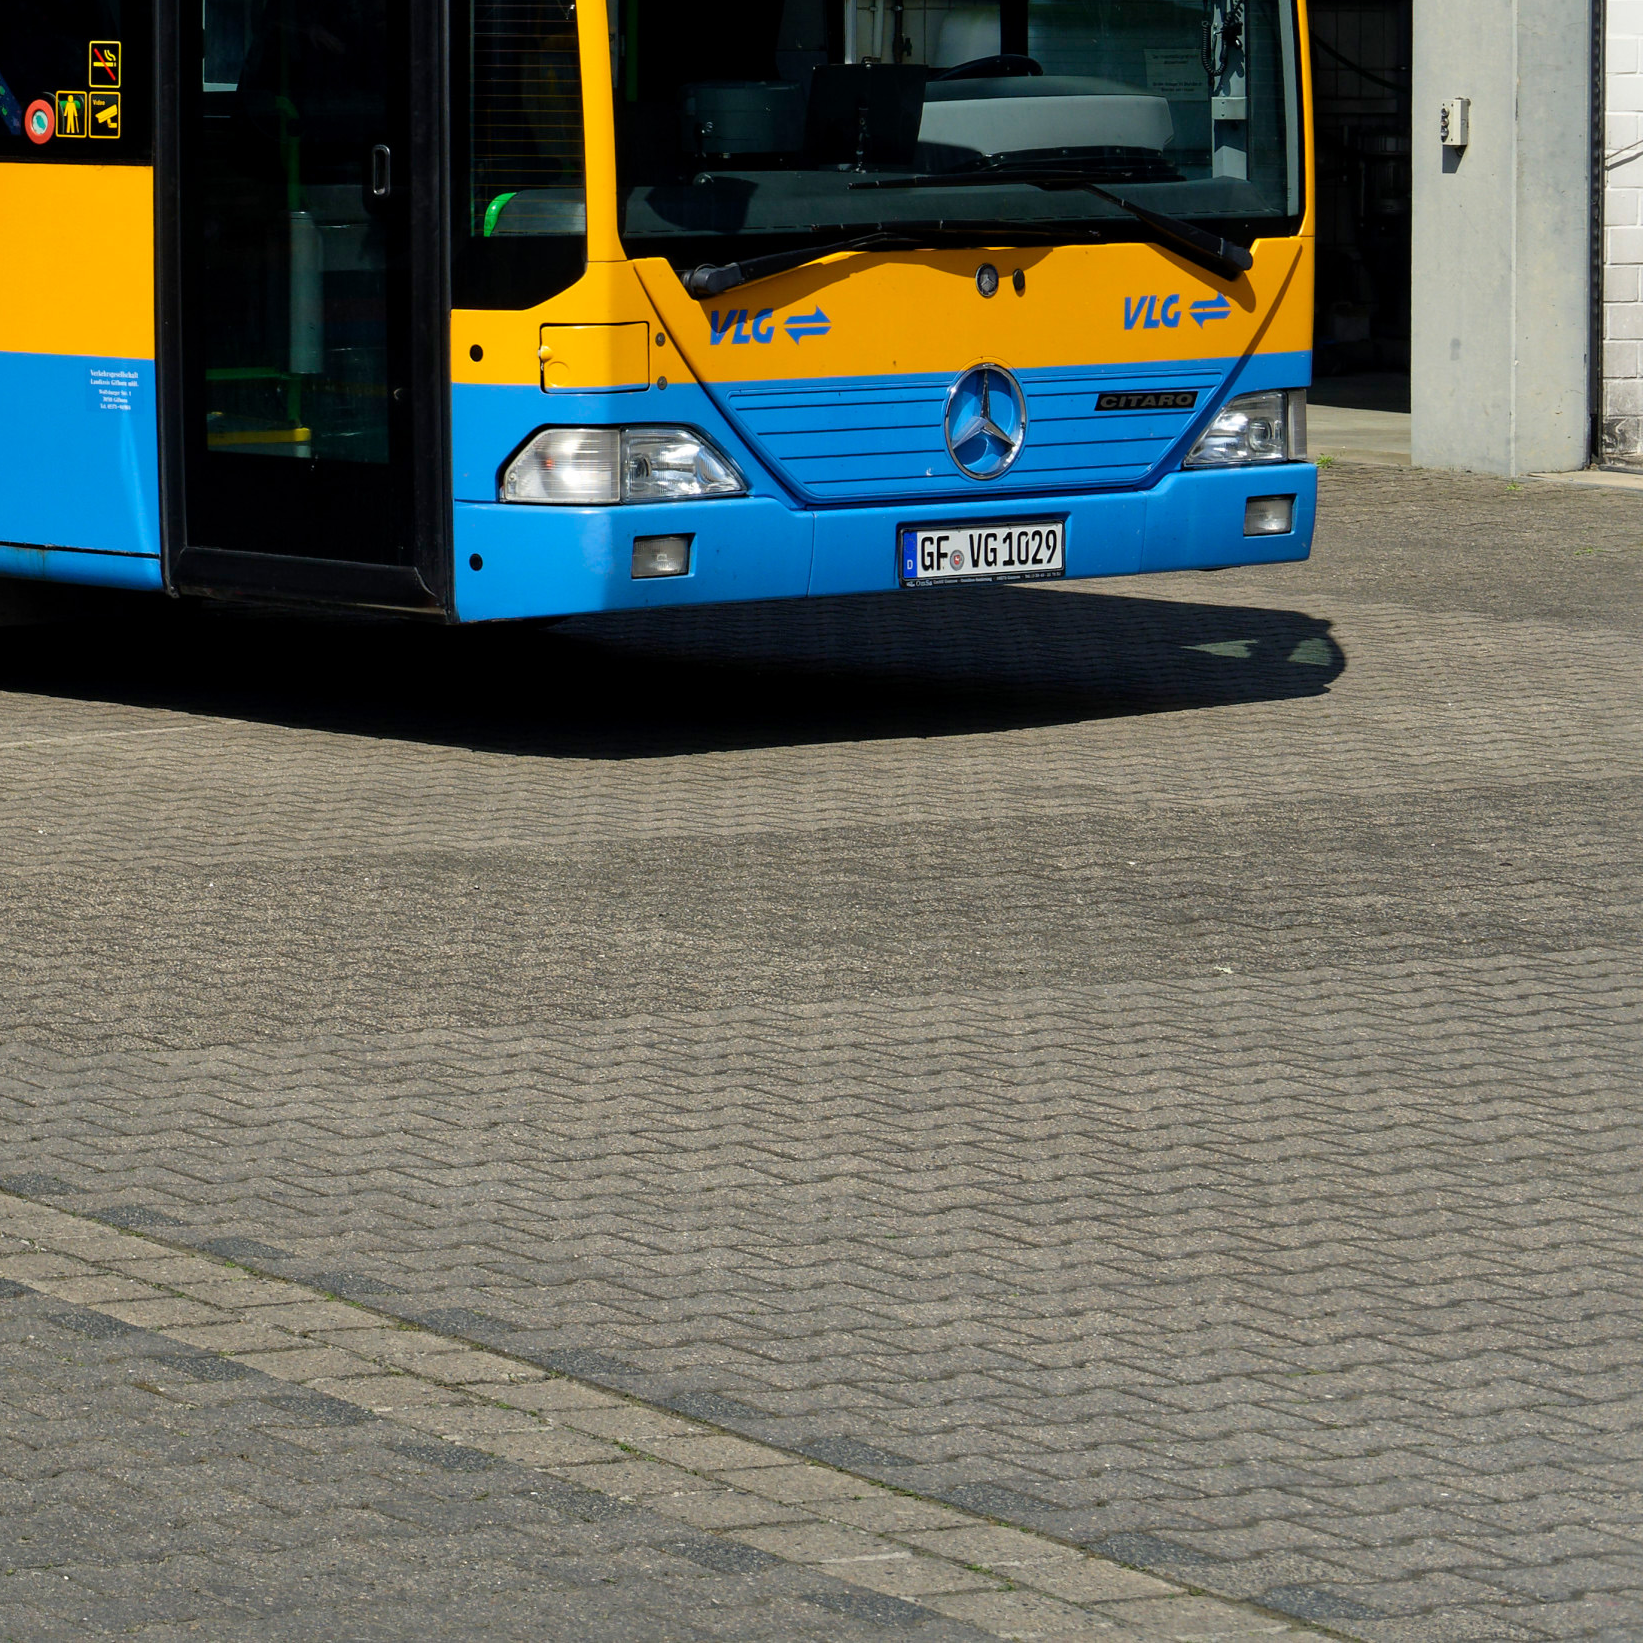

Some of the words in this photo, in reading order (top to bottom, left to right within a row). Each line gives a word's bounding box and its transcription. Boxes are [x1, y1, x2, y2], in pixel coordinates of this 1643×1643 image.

[709, 307, 775, 346] VLG
[1123, 294, 1182, 331] VLG
[1100, 393, 1193, 408] CITARO
[920, 535, 950, 571] GF
